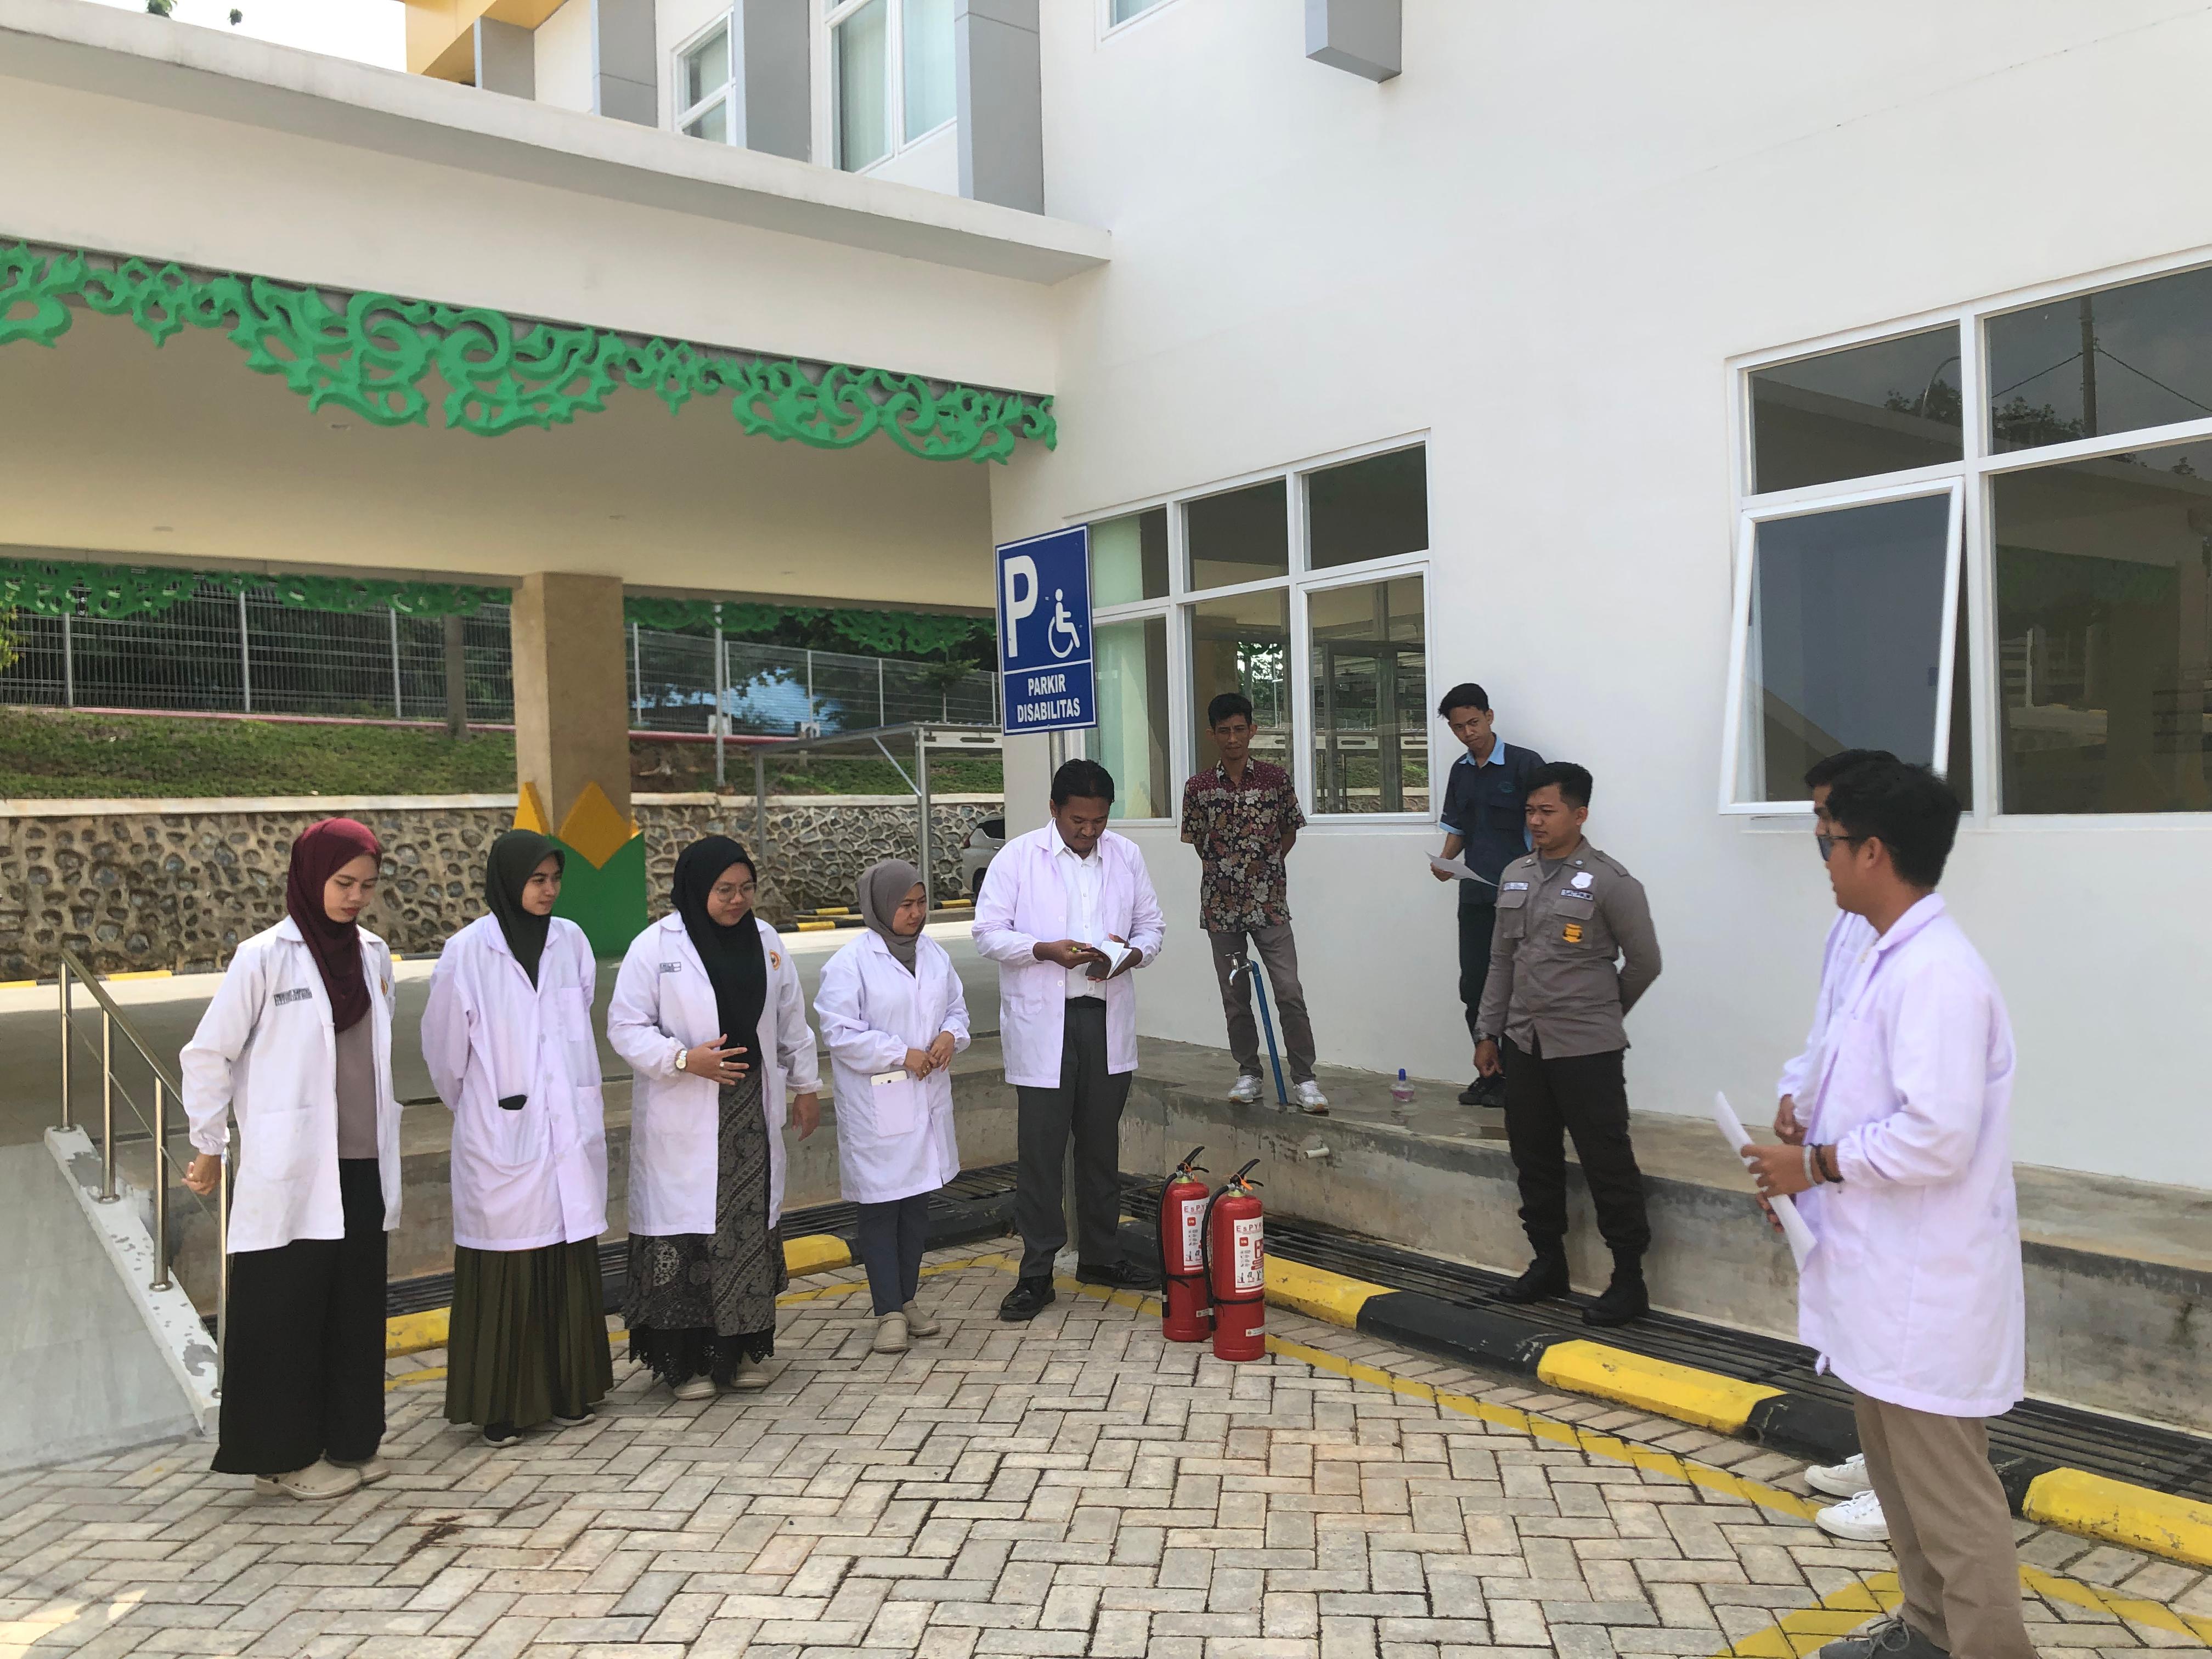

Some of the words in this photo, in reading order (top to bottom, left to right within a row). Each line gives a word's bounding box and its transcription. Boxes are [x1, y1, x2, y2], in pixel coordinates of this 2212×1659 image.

[1004, 555, 1038, 658] P
[1028, 674, 1066, 696] PARKIR
[1017, 698, 1080, 723] DISABILITAS
